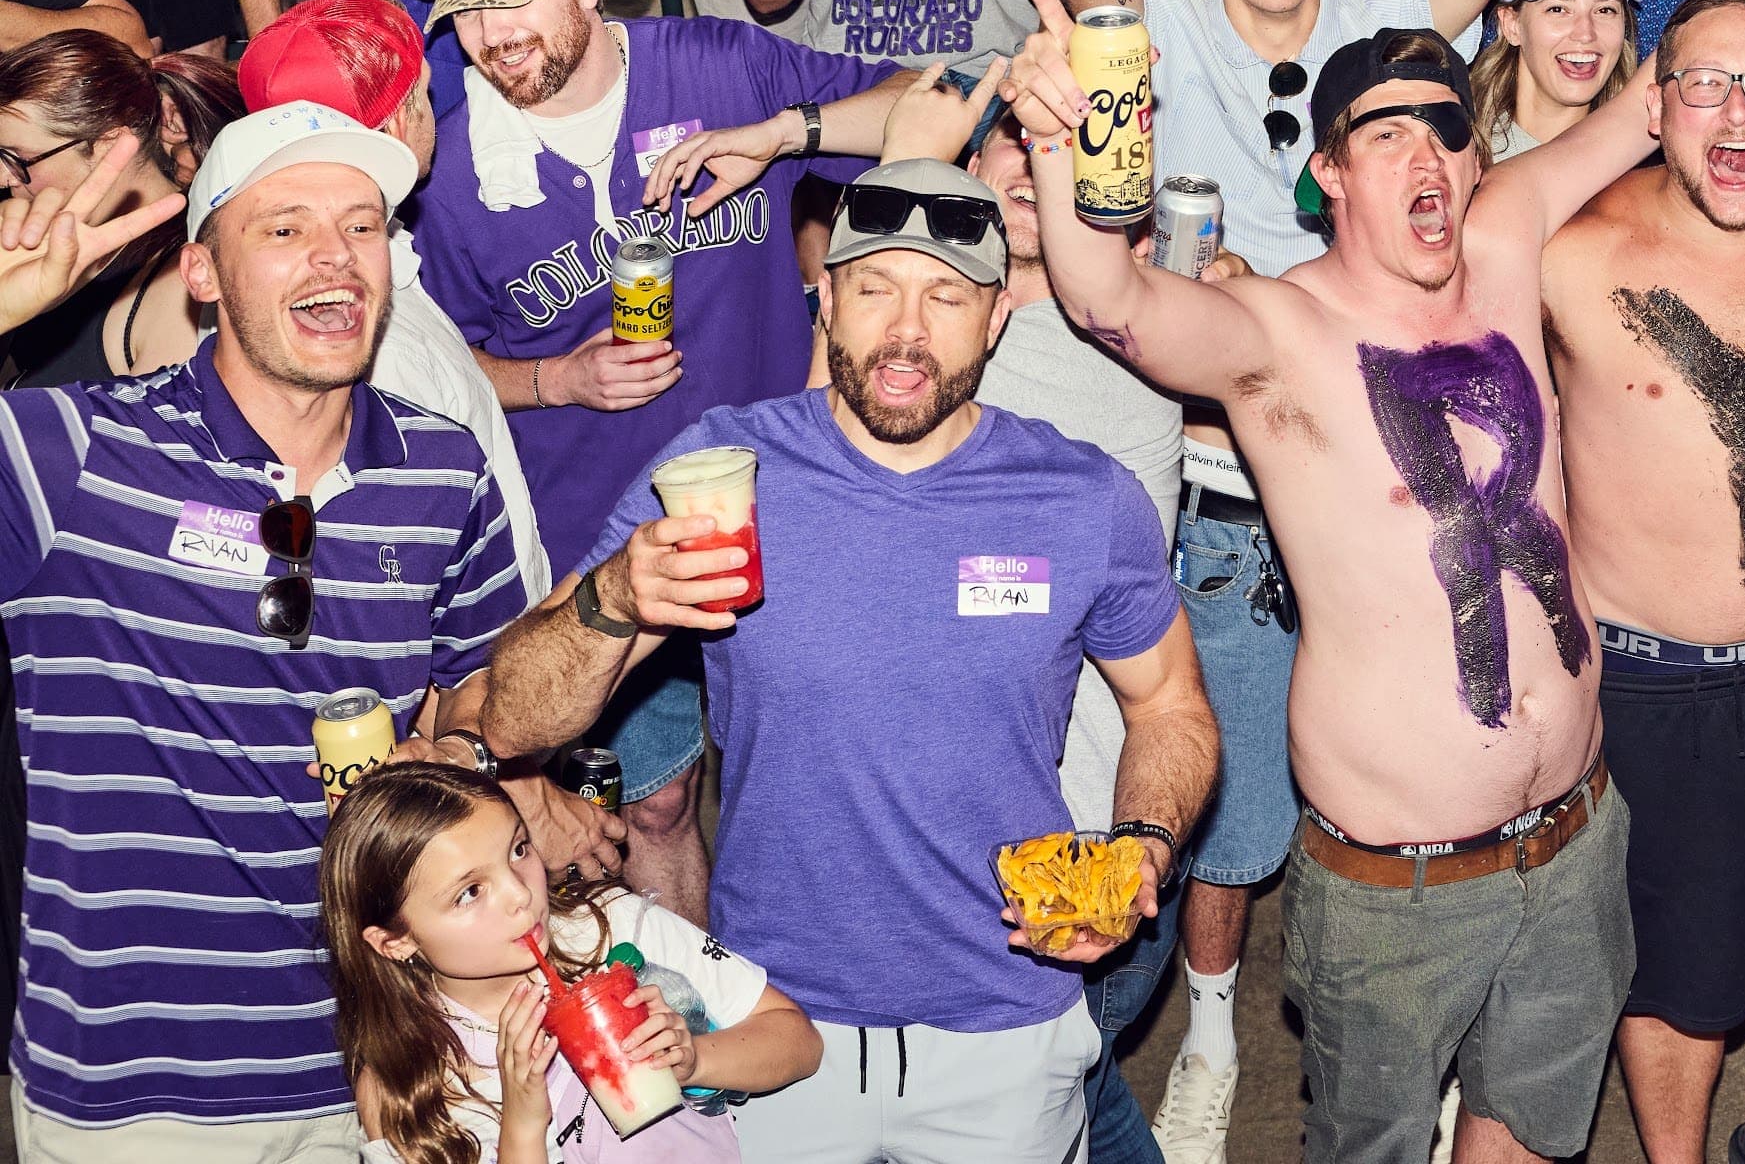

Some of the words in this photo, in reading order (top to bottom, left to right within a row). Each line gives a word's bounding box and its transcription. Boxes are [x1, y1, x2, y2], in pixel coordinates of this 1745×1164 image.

[844, 20, 973, 57] ROCKIES
[616, 319, 639, 333] HARD
[1182, 446, 1213, 468] Calvin
[1216, 459, 1244, 474] Klein
[205, 508, 254, 532] Hello
[180, 531, 248, 563] RYAN
[982, 557, 1028, 574] Hello
[969, 586, 1029, 608] RYAN
[1515, 806, 1543, 834] NBA
[1419, 843, 1454, 855] NBA
